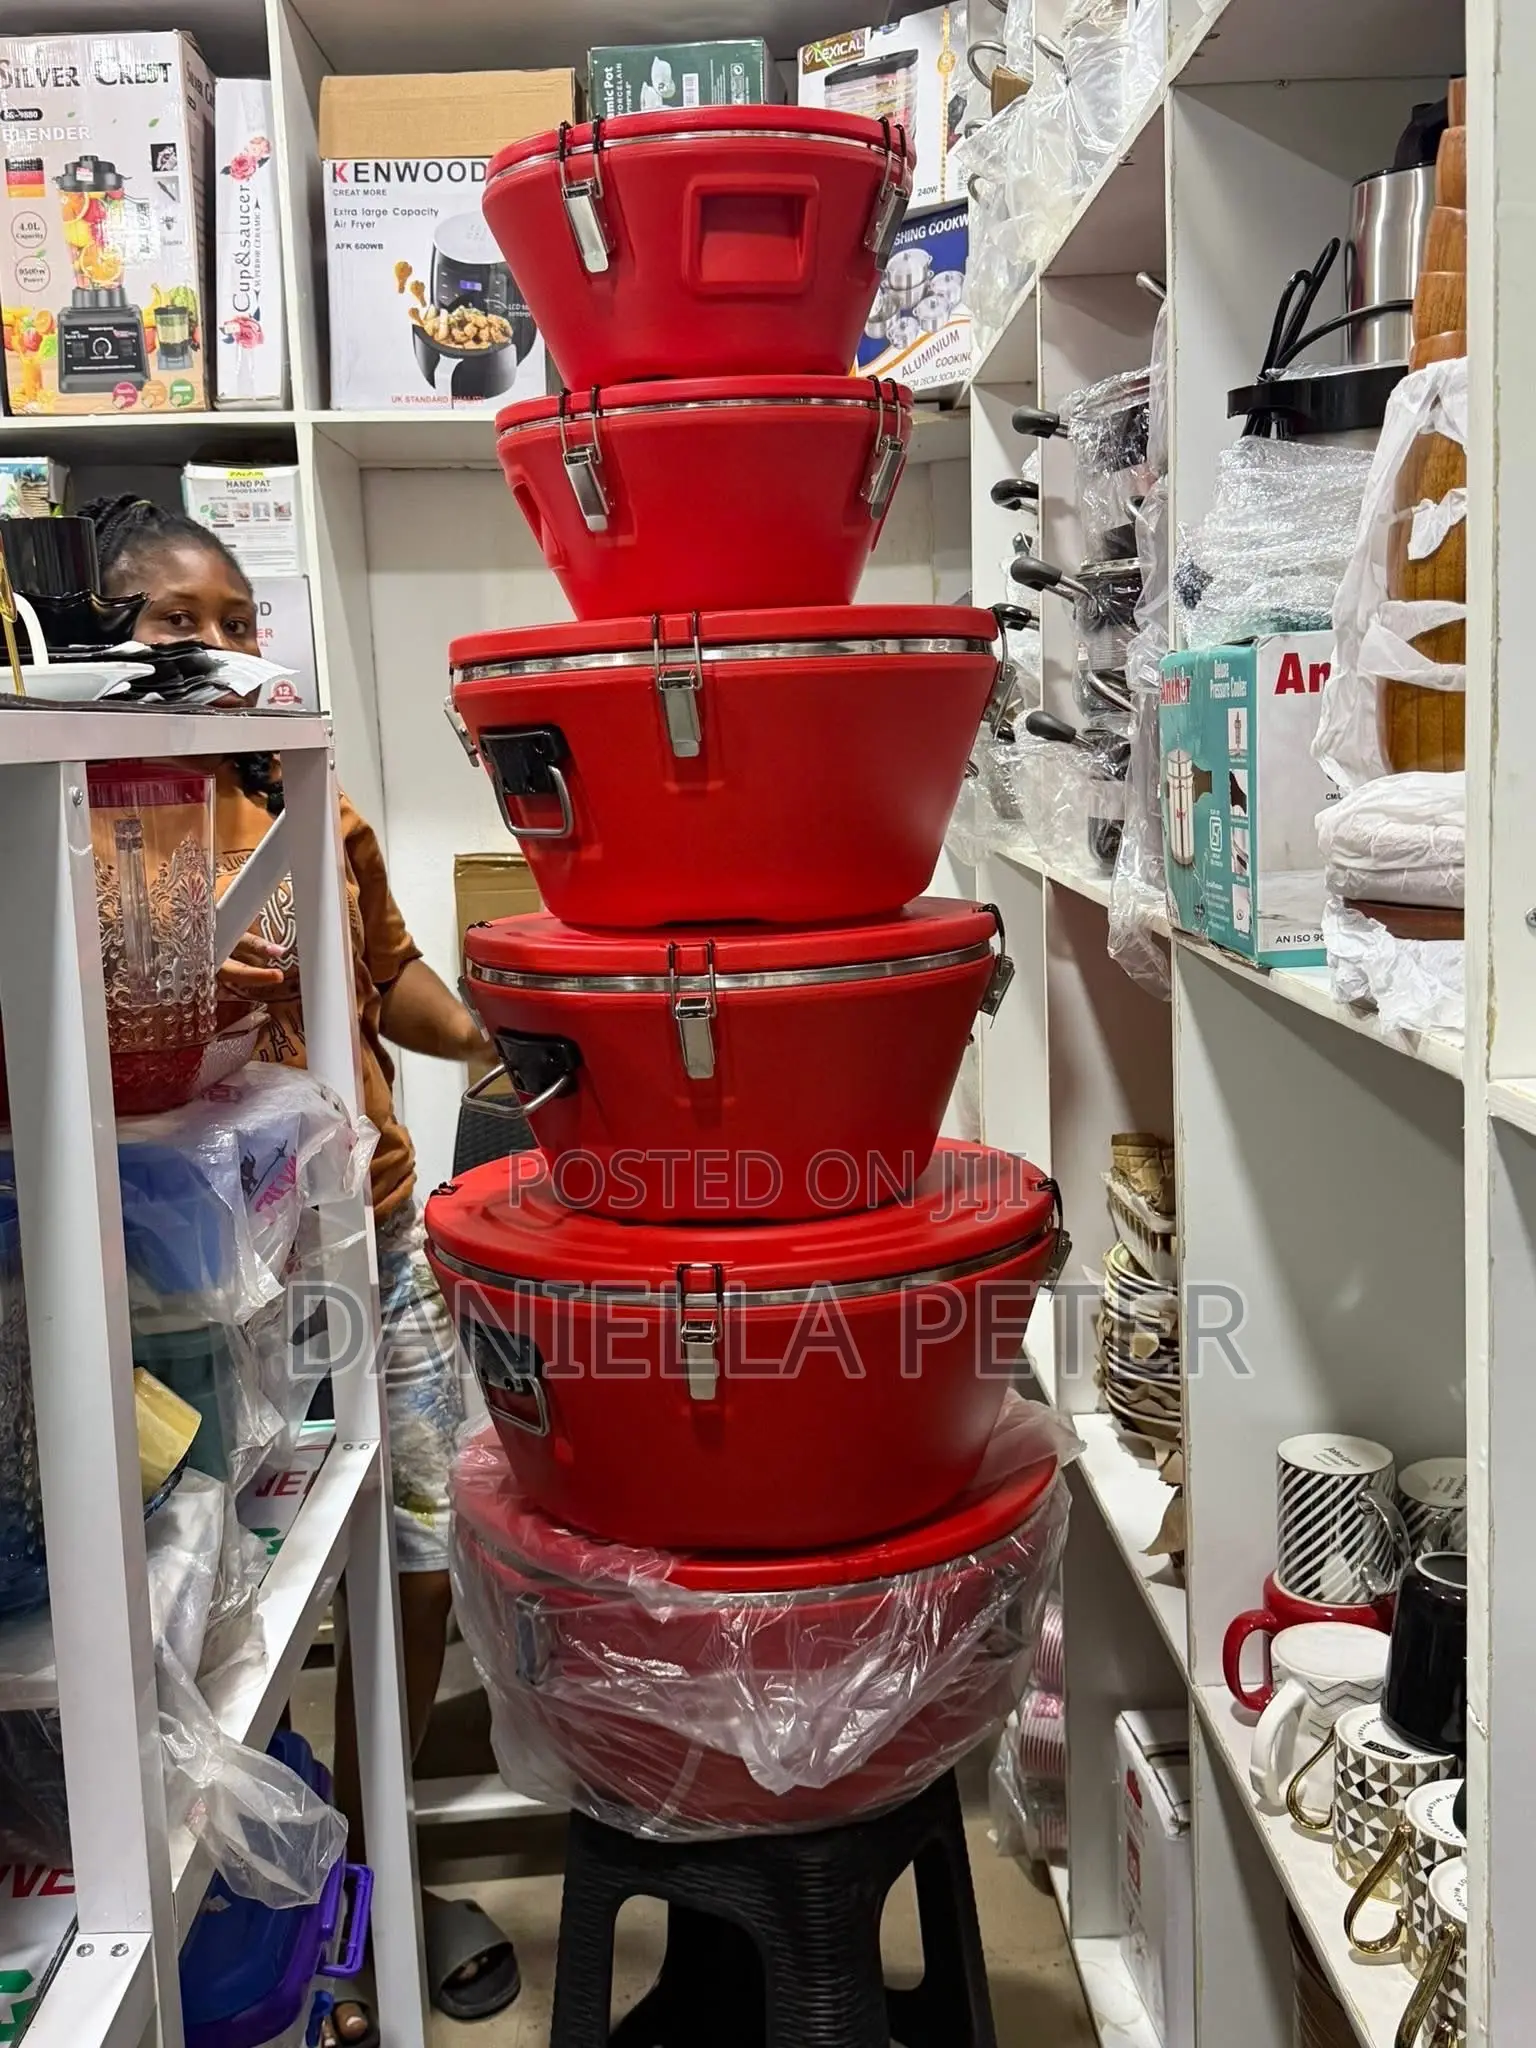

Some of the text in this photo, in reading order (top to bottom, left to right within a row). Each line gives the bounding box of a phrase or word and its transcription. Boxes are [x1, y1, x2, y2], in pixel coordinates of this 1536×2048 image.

[815, 38, 864, 63] LEXICAL
[0, 59, 172, 89] SILVER CREST
[604, 66, 614, 89] Pot
[2, 126, 90, 143] BLENDER
[332, 160, 487, 184] KENWOOD
[917, 184, 938, 198] 240W
[333, 207, 440, 220] Extra large Capacity
[334, 220, 376, 231] Air Fryer
[232, 184, 254, 313] Cup&saucer
[901, 329, 961, 379] ALUMINIUM
[391, 394, 403, 404] UK
[404, 394, 449, 404] STANDARD
[226, 480, 253, 489] HAND
[1275, 935, 1291, 944] AN
[1293, 933, 1311, 943] ISO
